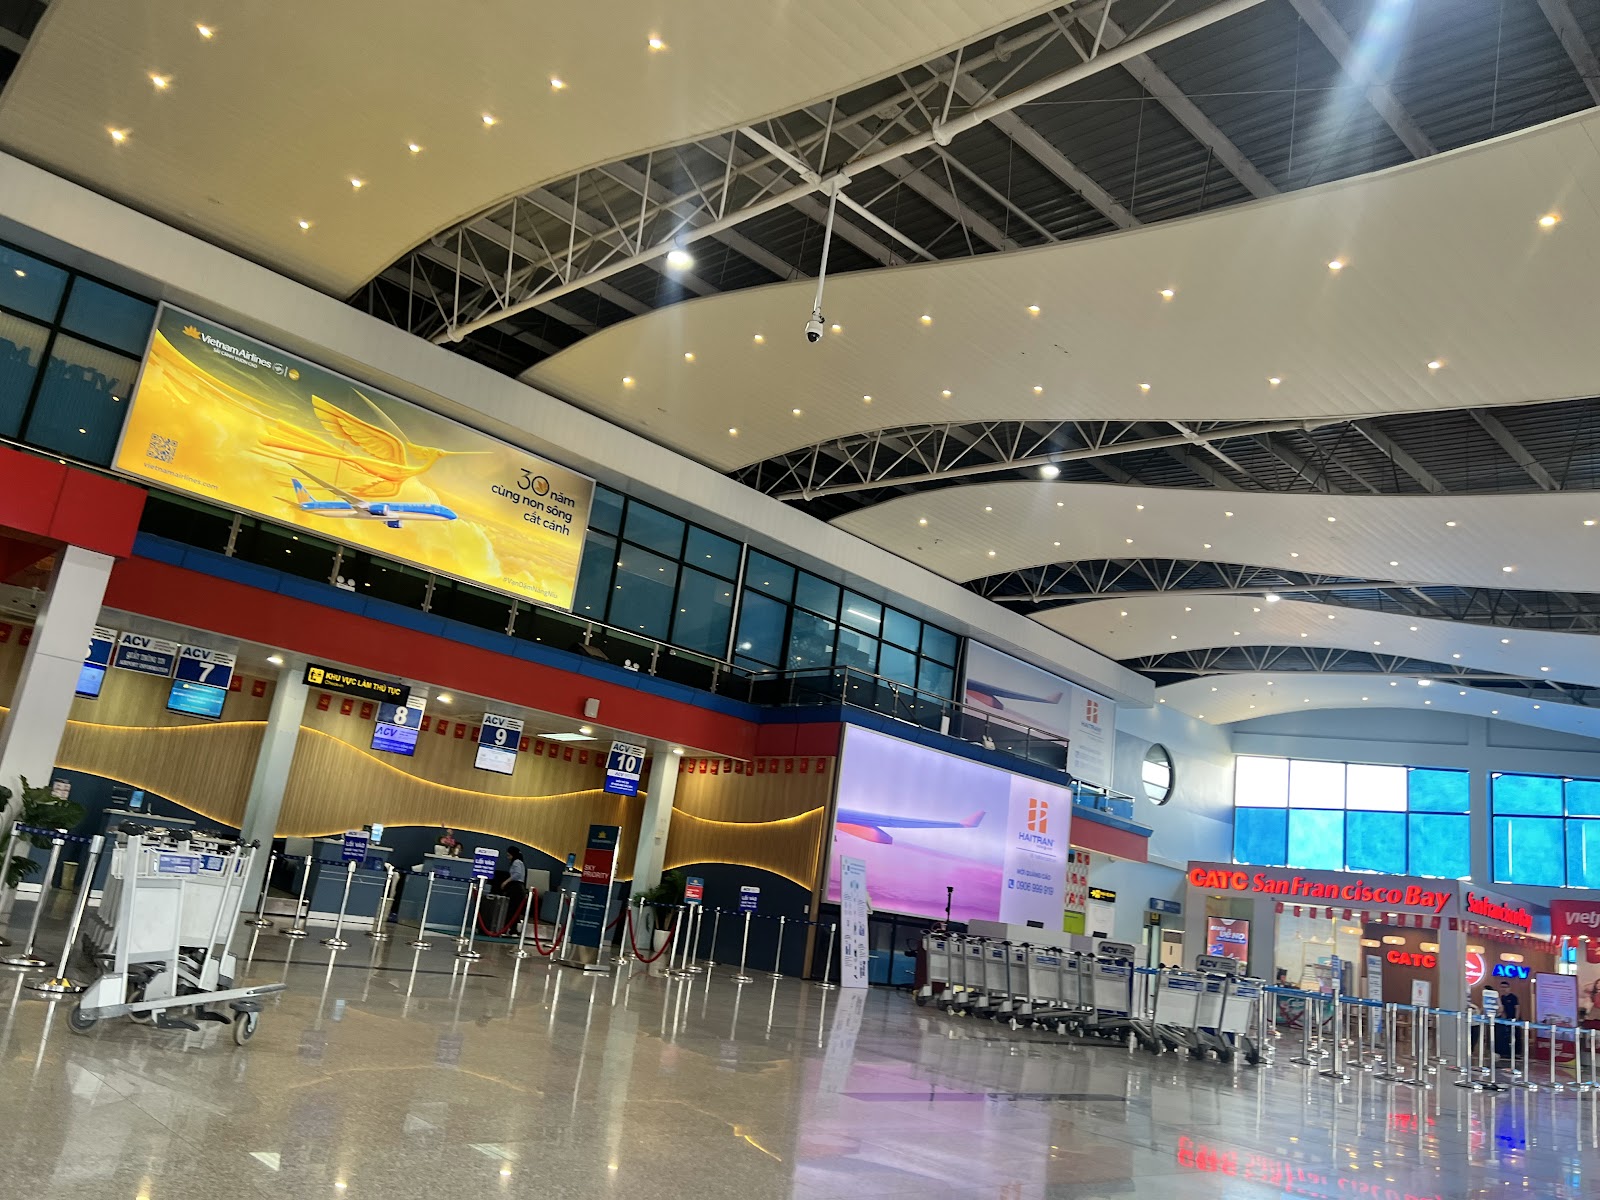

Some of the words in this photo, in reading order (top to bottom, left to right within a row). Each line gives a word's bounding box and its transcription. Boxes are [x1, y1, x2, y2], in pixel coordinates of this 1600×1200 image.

[143, 462, 219, 490] vietnamairlines.com
[517, 467, 550, 497] 30
[550, 491, 575, 508] năm
[491, 484, 521, 504] cùng
[522, 496, 545, 511] non
[546, 505, 573, 524] sông
[523, 511, 541, 526] cất
[543, 520, 570, 536] cánh
[122, 634, 151, 648] ACV
[182, 647, 211, 660] ACV
[198, 662, 215, 683] 7
[325, 672, 341, 682] KHU
[393, 706, 409, 725] 8
[484, 716, 505, 726] ACV
[375, 726, 397, 737] ACV
[494, 728, 508, 746] 9
[613, 743, 630, 753] ACV
[617, 754, 637, 773] 10
[1189, 867, 1249, 891] CATC
[1252, 872, 1290, 894] San
[1404, 885, 1451, 913] Bay
[1387, 950, 1436, 968] CATC
[1492, 963, 1531, 979] ACV
